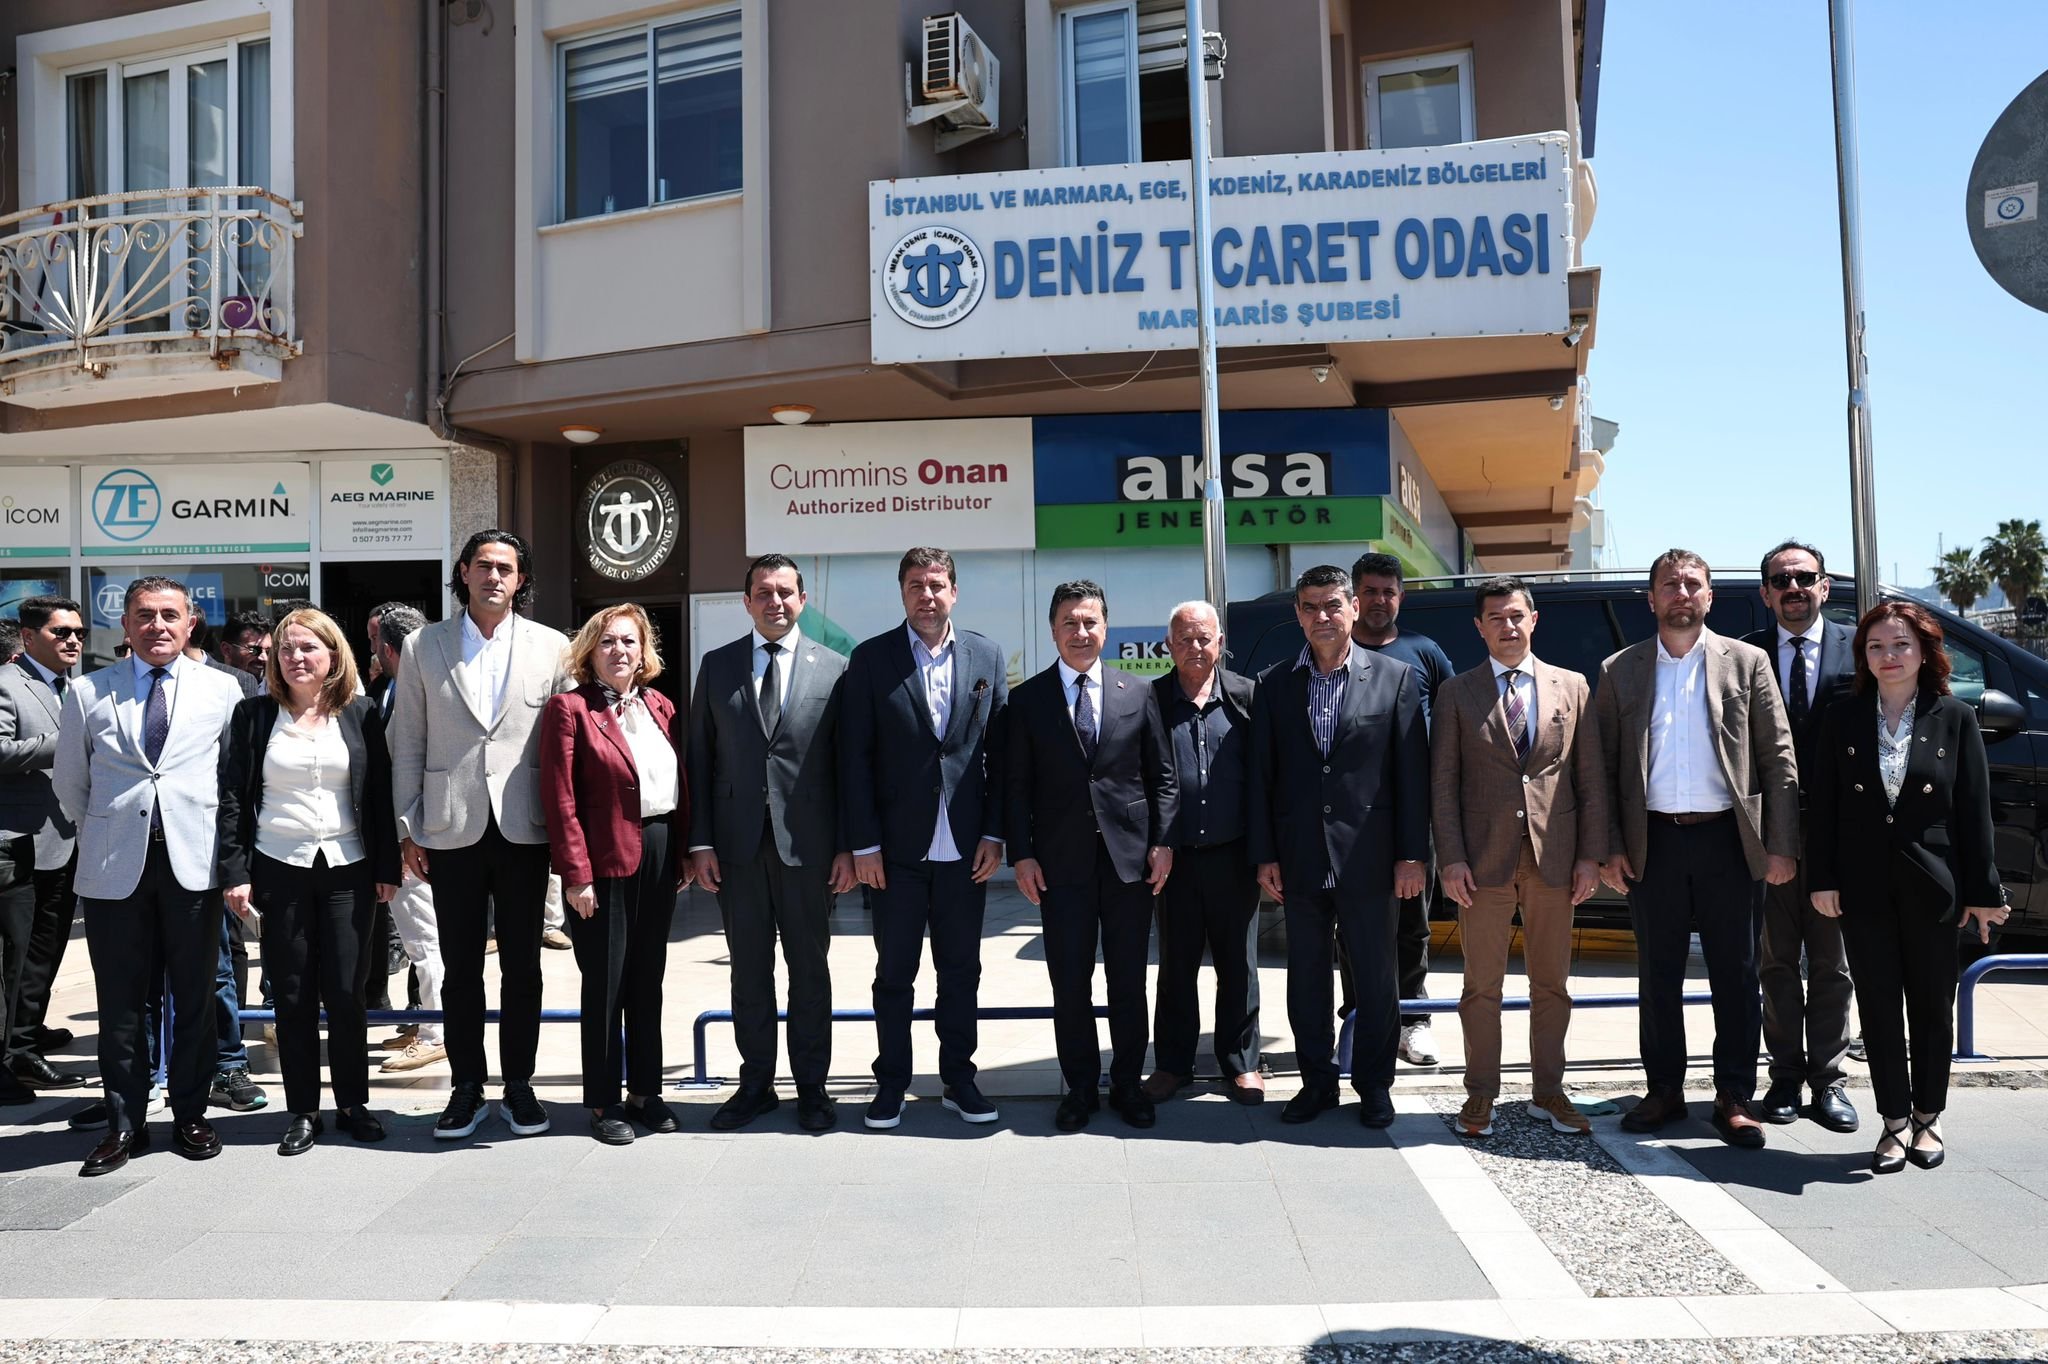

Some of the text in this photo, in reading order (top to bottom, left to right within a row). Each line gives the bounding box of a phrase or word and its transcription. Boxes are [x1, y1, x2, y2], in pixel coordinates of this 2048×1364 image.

[885, 158, 1547, 216] İSTANBUL VE MARMARA, EGE, KDENİZ, KARADENİZ BÖLGELERİ
[962, 244, 978, 269] ODASI
[994, 213, 1550, 300] DENİZ TCARET ODASI
[1297, 294, 1401, 327] ŞUBESİ
[770, 459, 1008, 490] Cummins Onan
[330, 490, 435, 503] AEG MARINE
[651, 473, 675, 514] ODASI
[786, 495, 993, 515] Authorized Distributor
[1400, 464, 1421, 526] aksa
[5, 507, 60, 524] ICOM
[171, 498, 290, 520] GARMIN
[1116, 504, 1332, 534] JENEATÖR
[141, 545, 252, 554] AUTHORIZED SERVICES
[352, 535, 358, 543] 0
[359, 535, 374, 543] 507
[636, 529, 673, 577] SHIPPING
[264, 573, 309, 587] ICOM
[1121, 641, 1172, 659] aks
